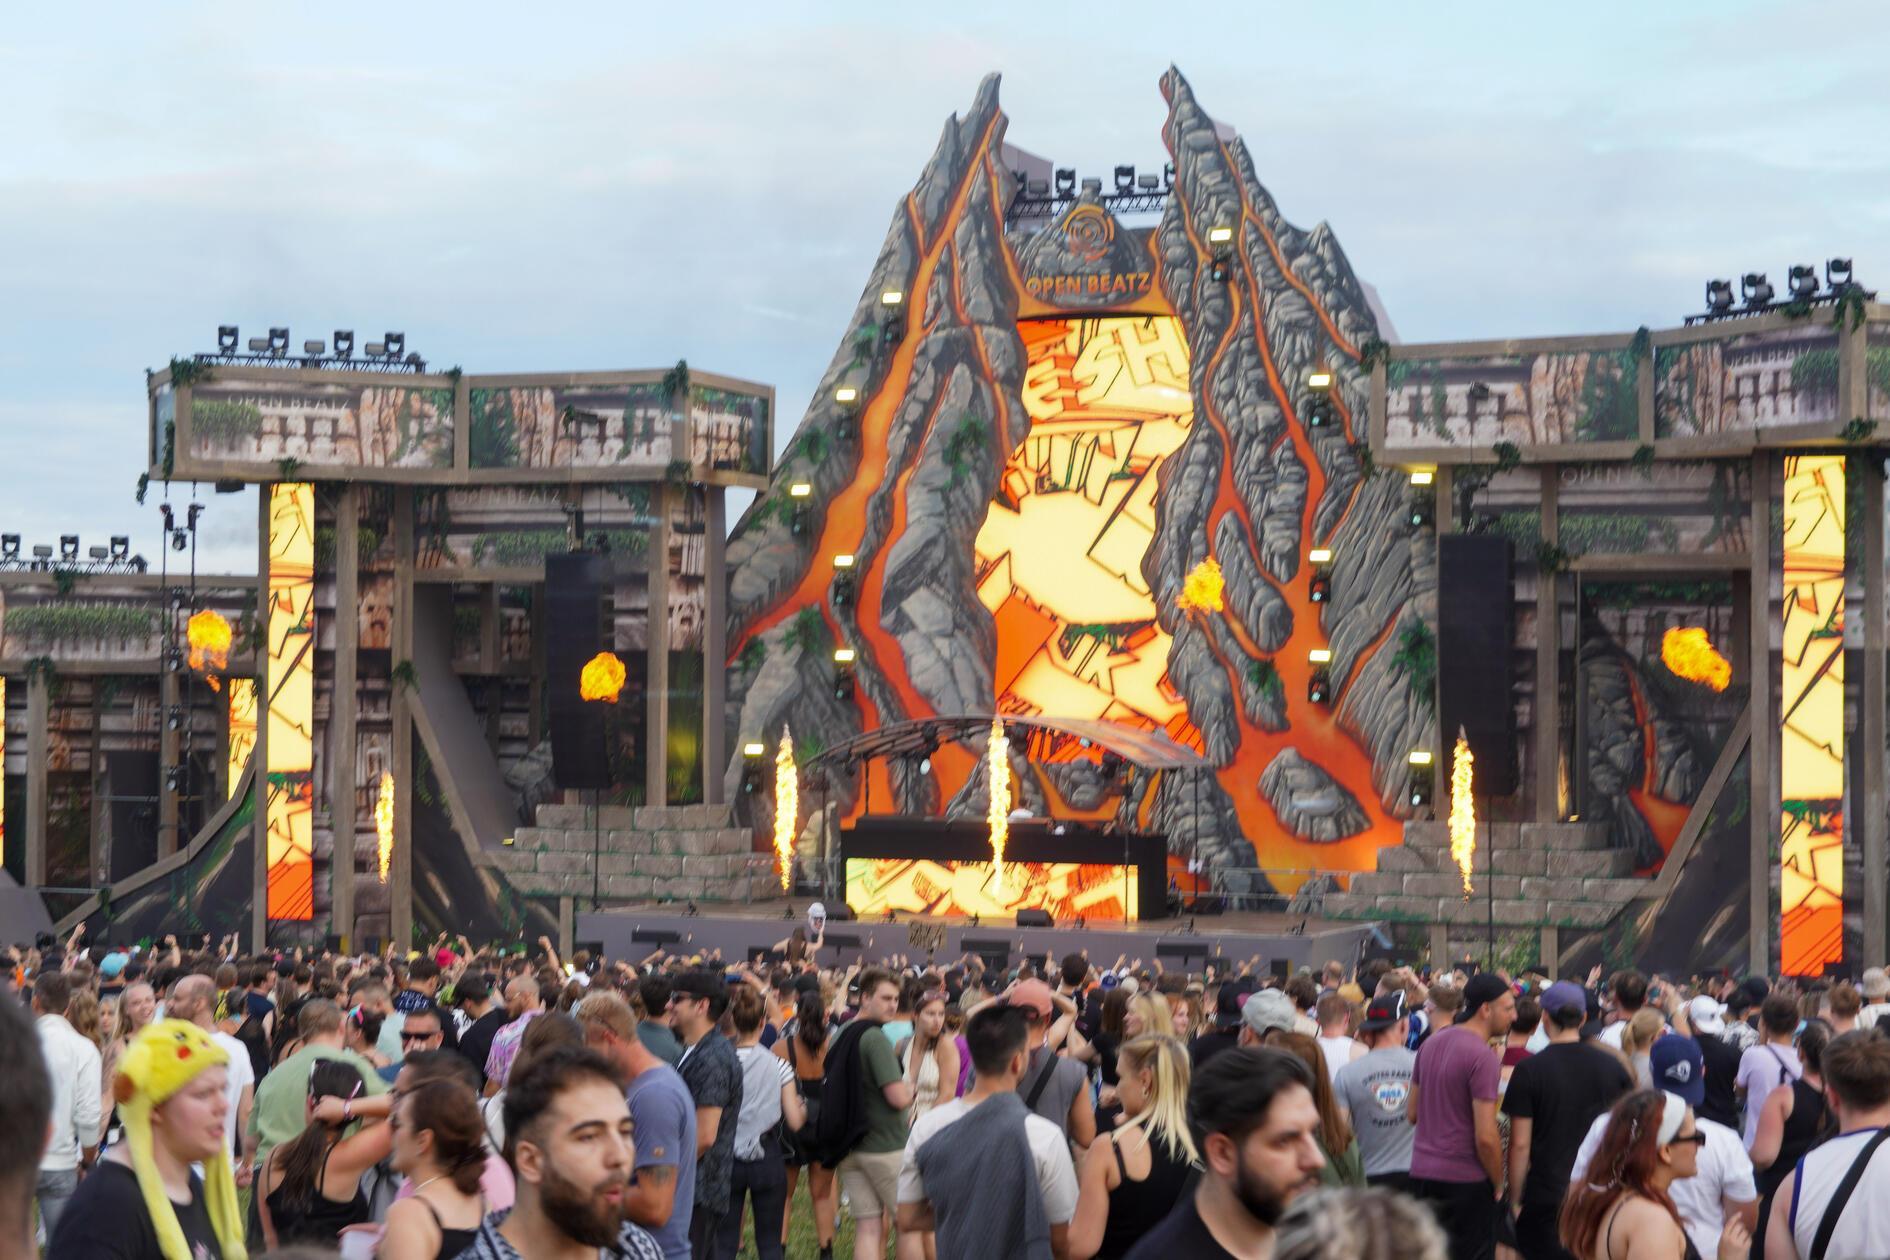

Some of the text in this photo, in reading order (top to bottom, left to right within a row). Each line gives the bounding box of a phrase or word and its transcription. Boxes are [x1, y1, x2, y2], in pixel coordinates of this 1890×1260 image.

[1025, 271, 1151, 295] OPEN BEATZ
[1561, 463, 1697, 485] OPEN BATZ
